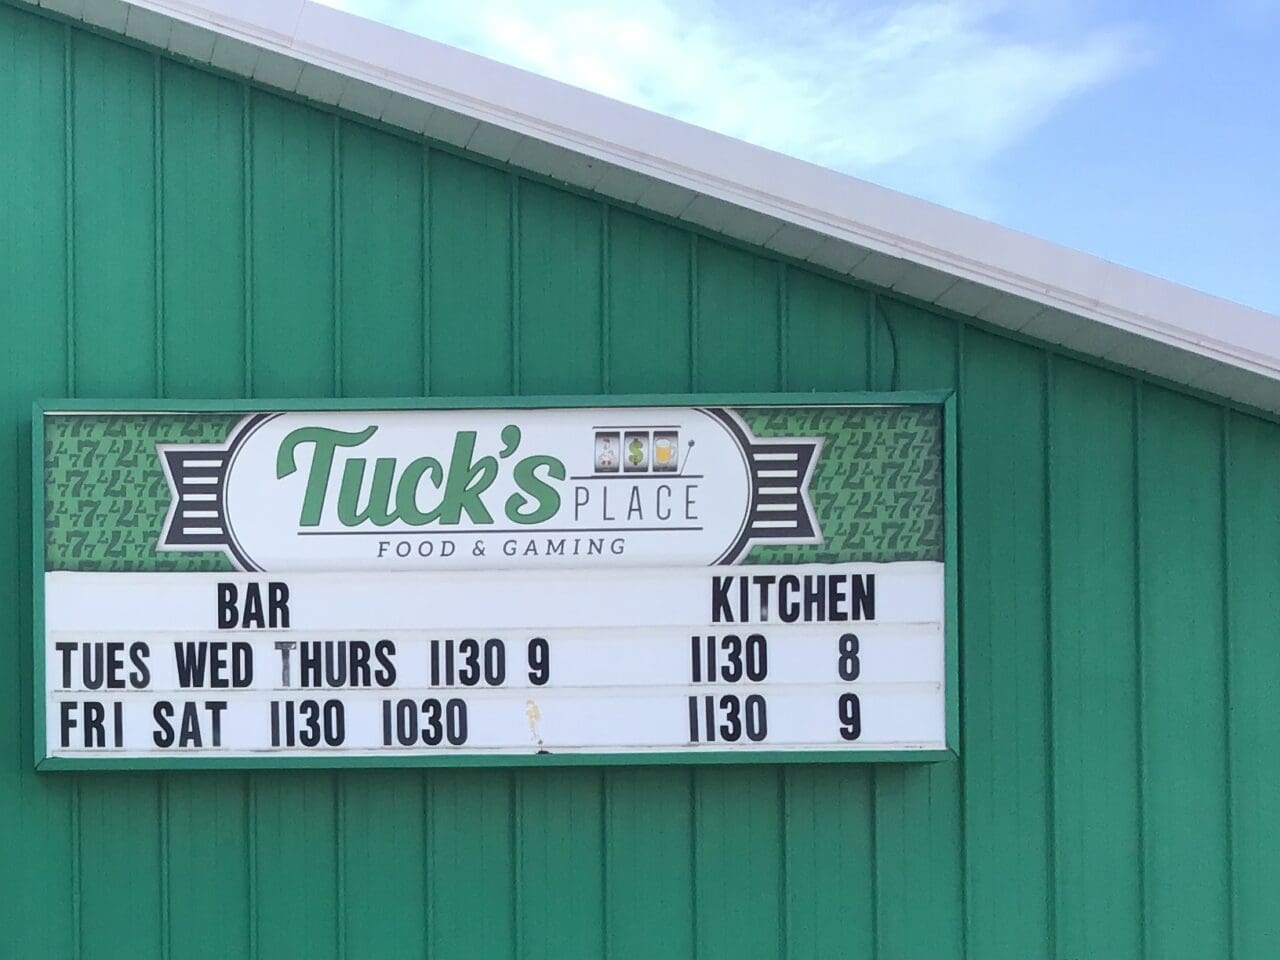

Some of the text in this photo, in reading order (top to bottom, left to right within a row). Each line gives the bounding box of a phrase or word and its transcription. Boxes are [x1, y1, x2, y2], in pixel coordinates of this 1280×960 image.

[277, 424, 698, 527] Tuck's PLACE
[377, 538, 626, 558] FOOD & GAMING
[217, 581, 290, 630] BAR
[711, 574, 875, 623] KITCHEN
[55, 637, 550, 690] TUES WED THURS 1130 9
[691, 633, 860, 682] 1130 8
[61, 698, 468, 748] FRI SAT 1130 1030
[687, 692, 862, 742] 1130 9
